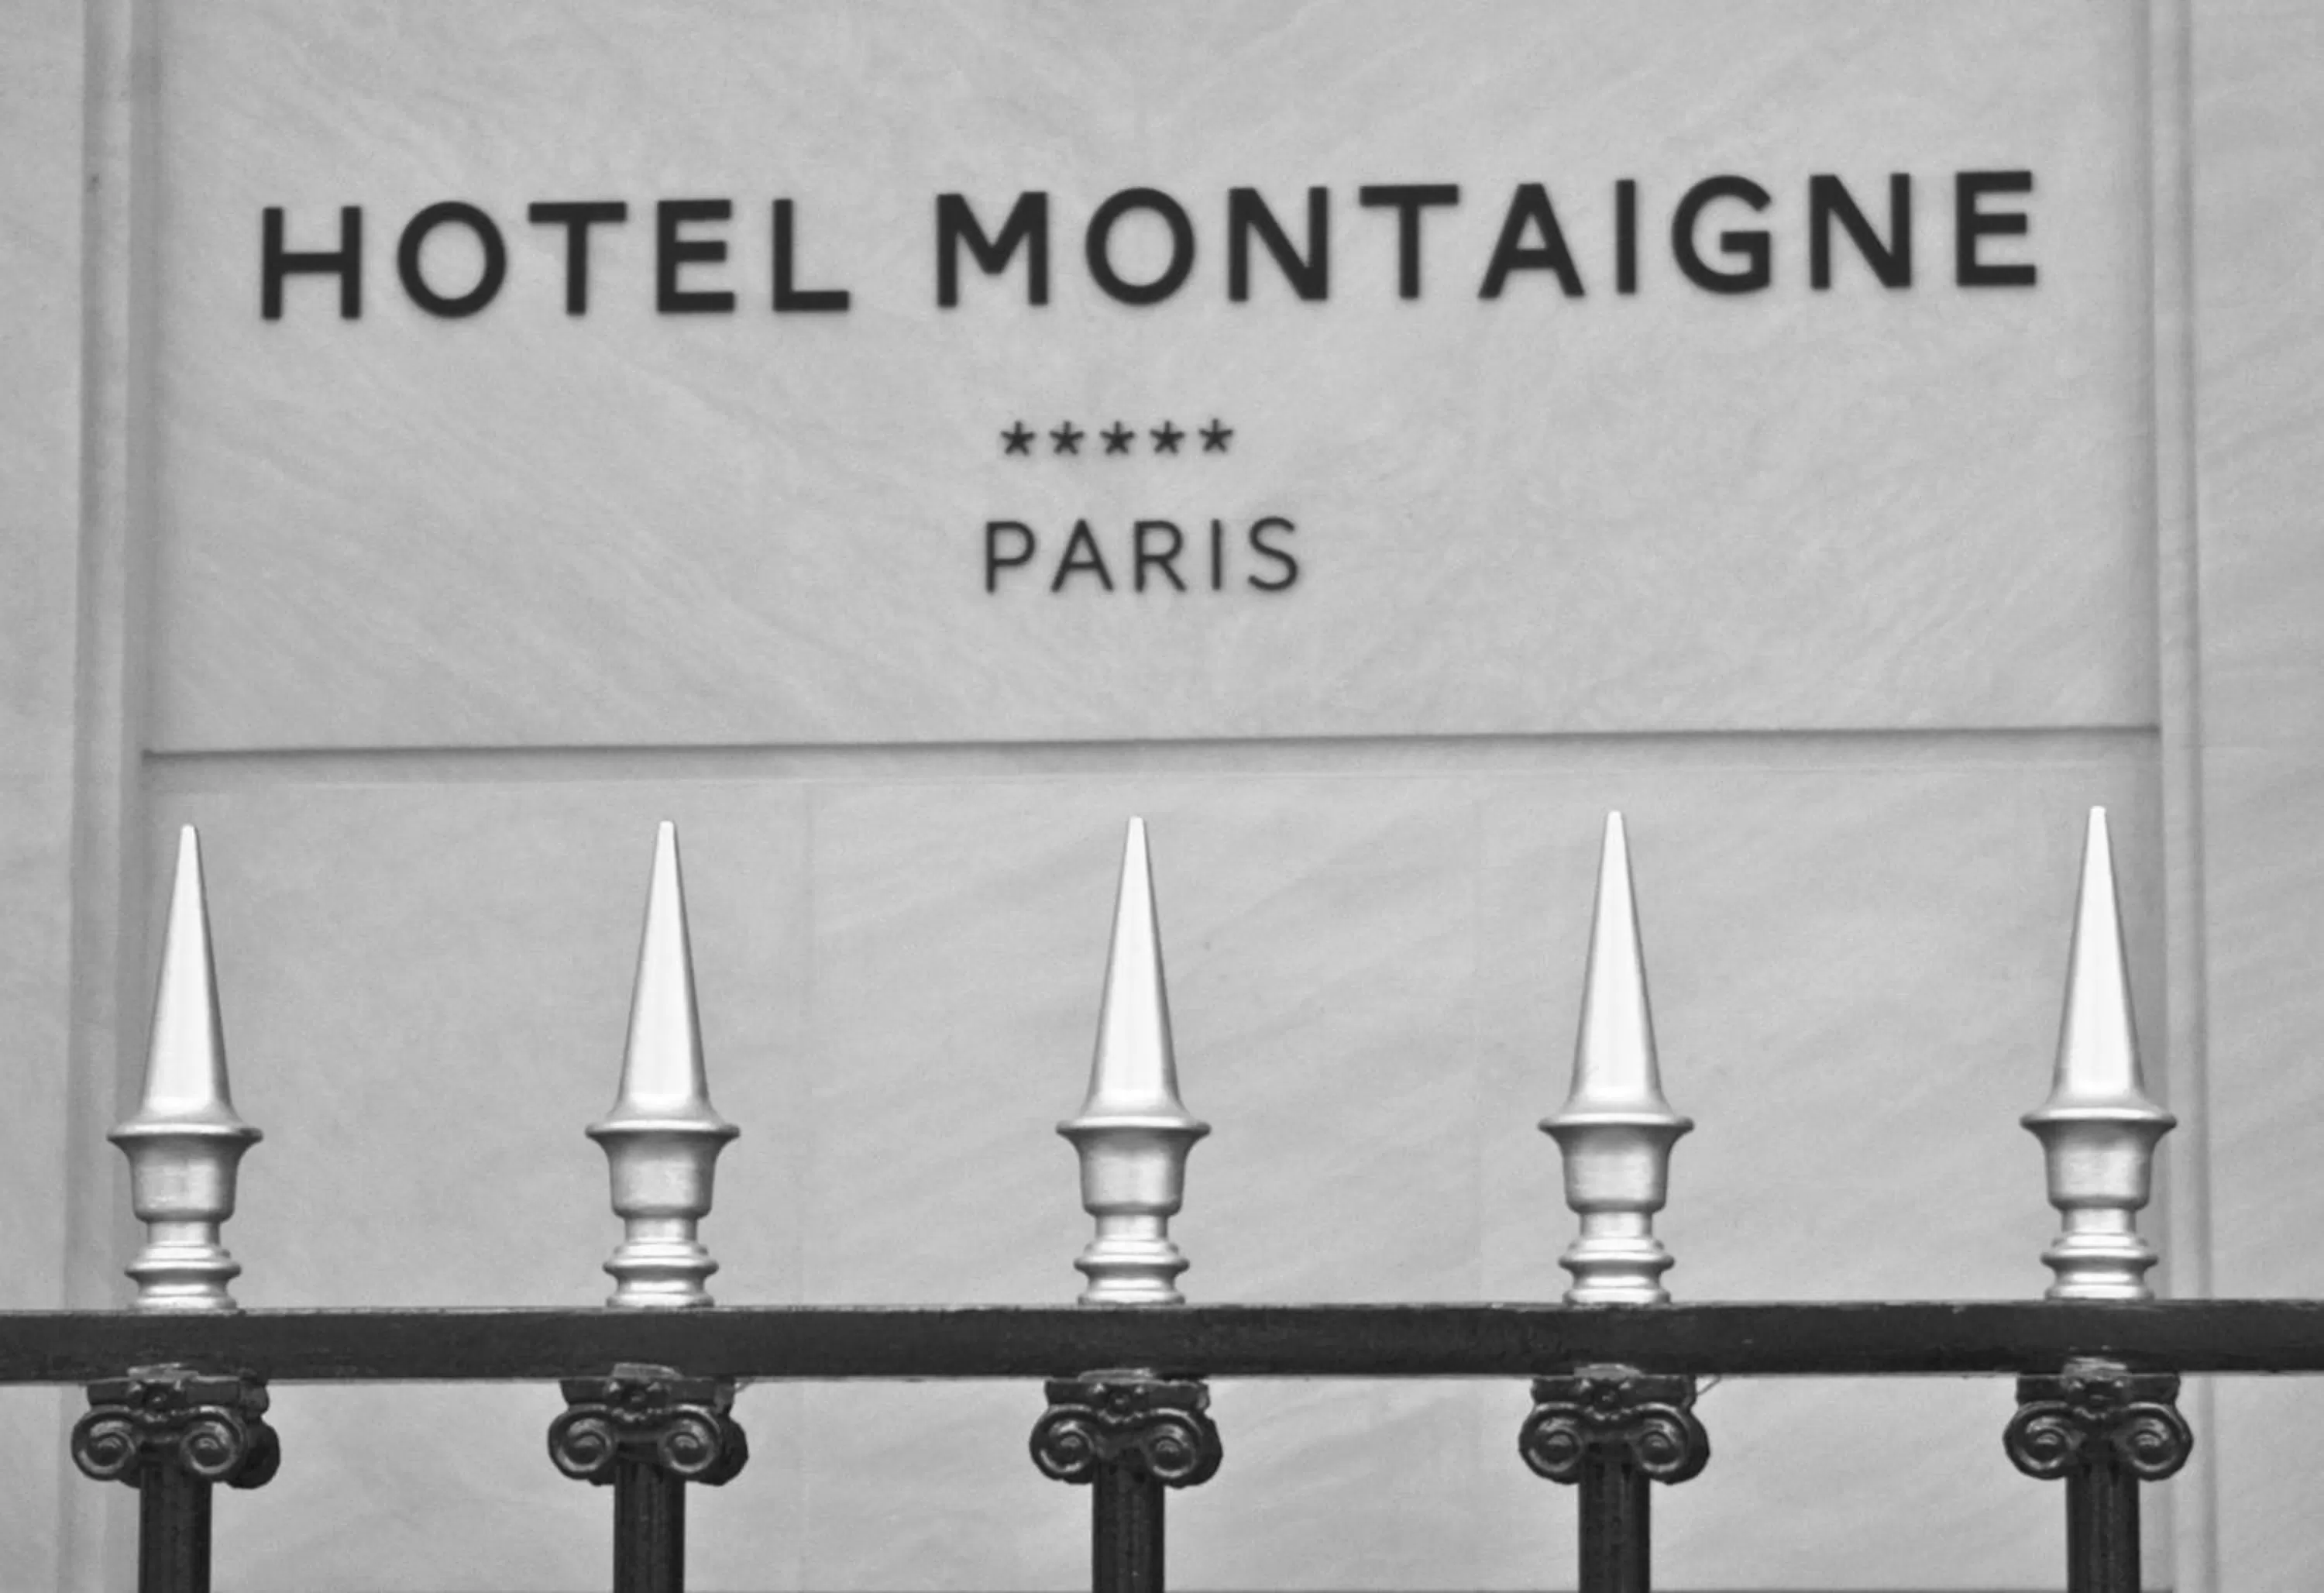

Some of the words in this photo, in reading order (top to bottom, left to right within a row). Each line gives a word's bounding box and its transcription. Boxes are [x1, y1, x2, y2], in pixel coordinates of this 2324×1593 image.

[260, 198, 851, 322] HOTEL
[935, 169, 2038, 309] MONTAIGNE
[984, 515, 1300, 594] PARIS
